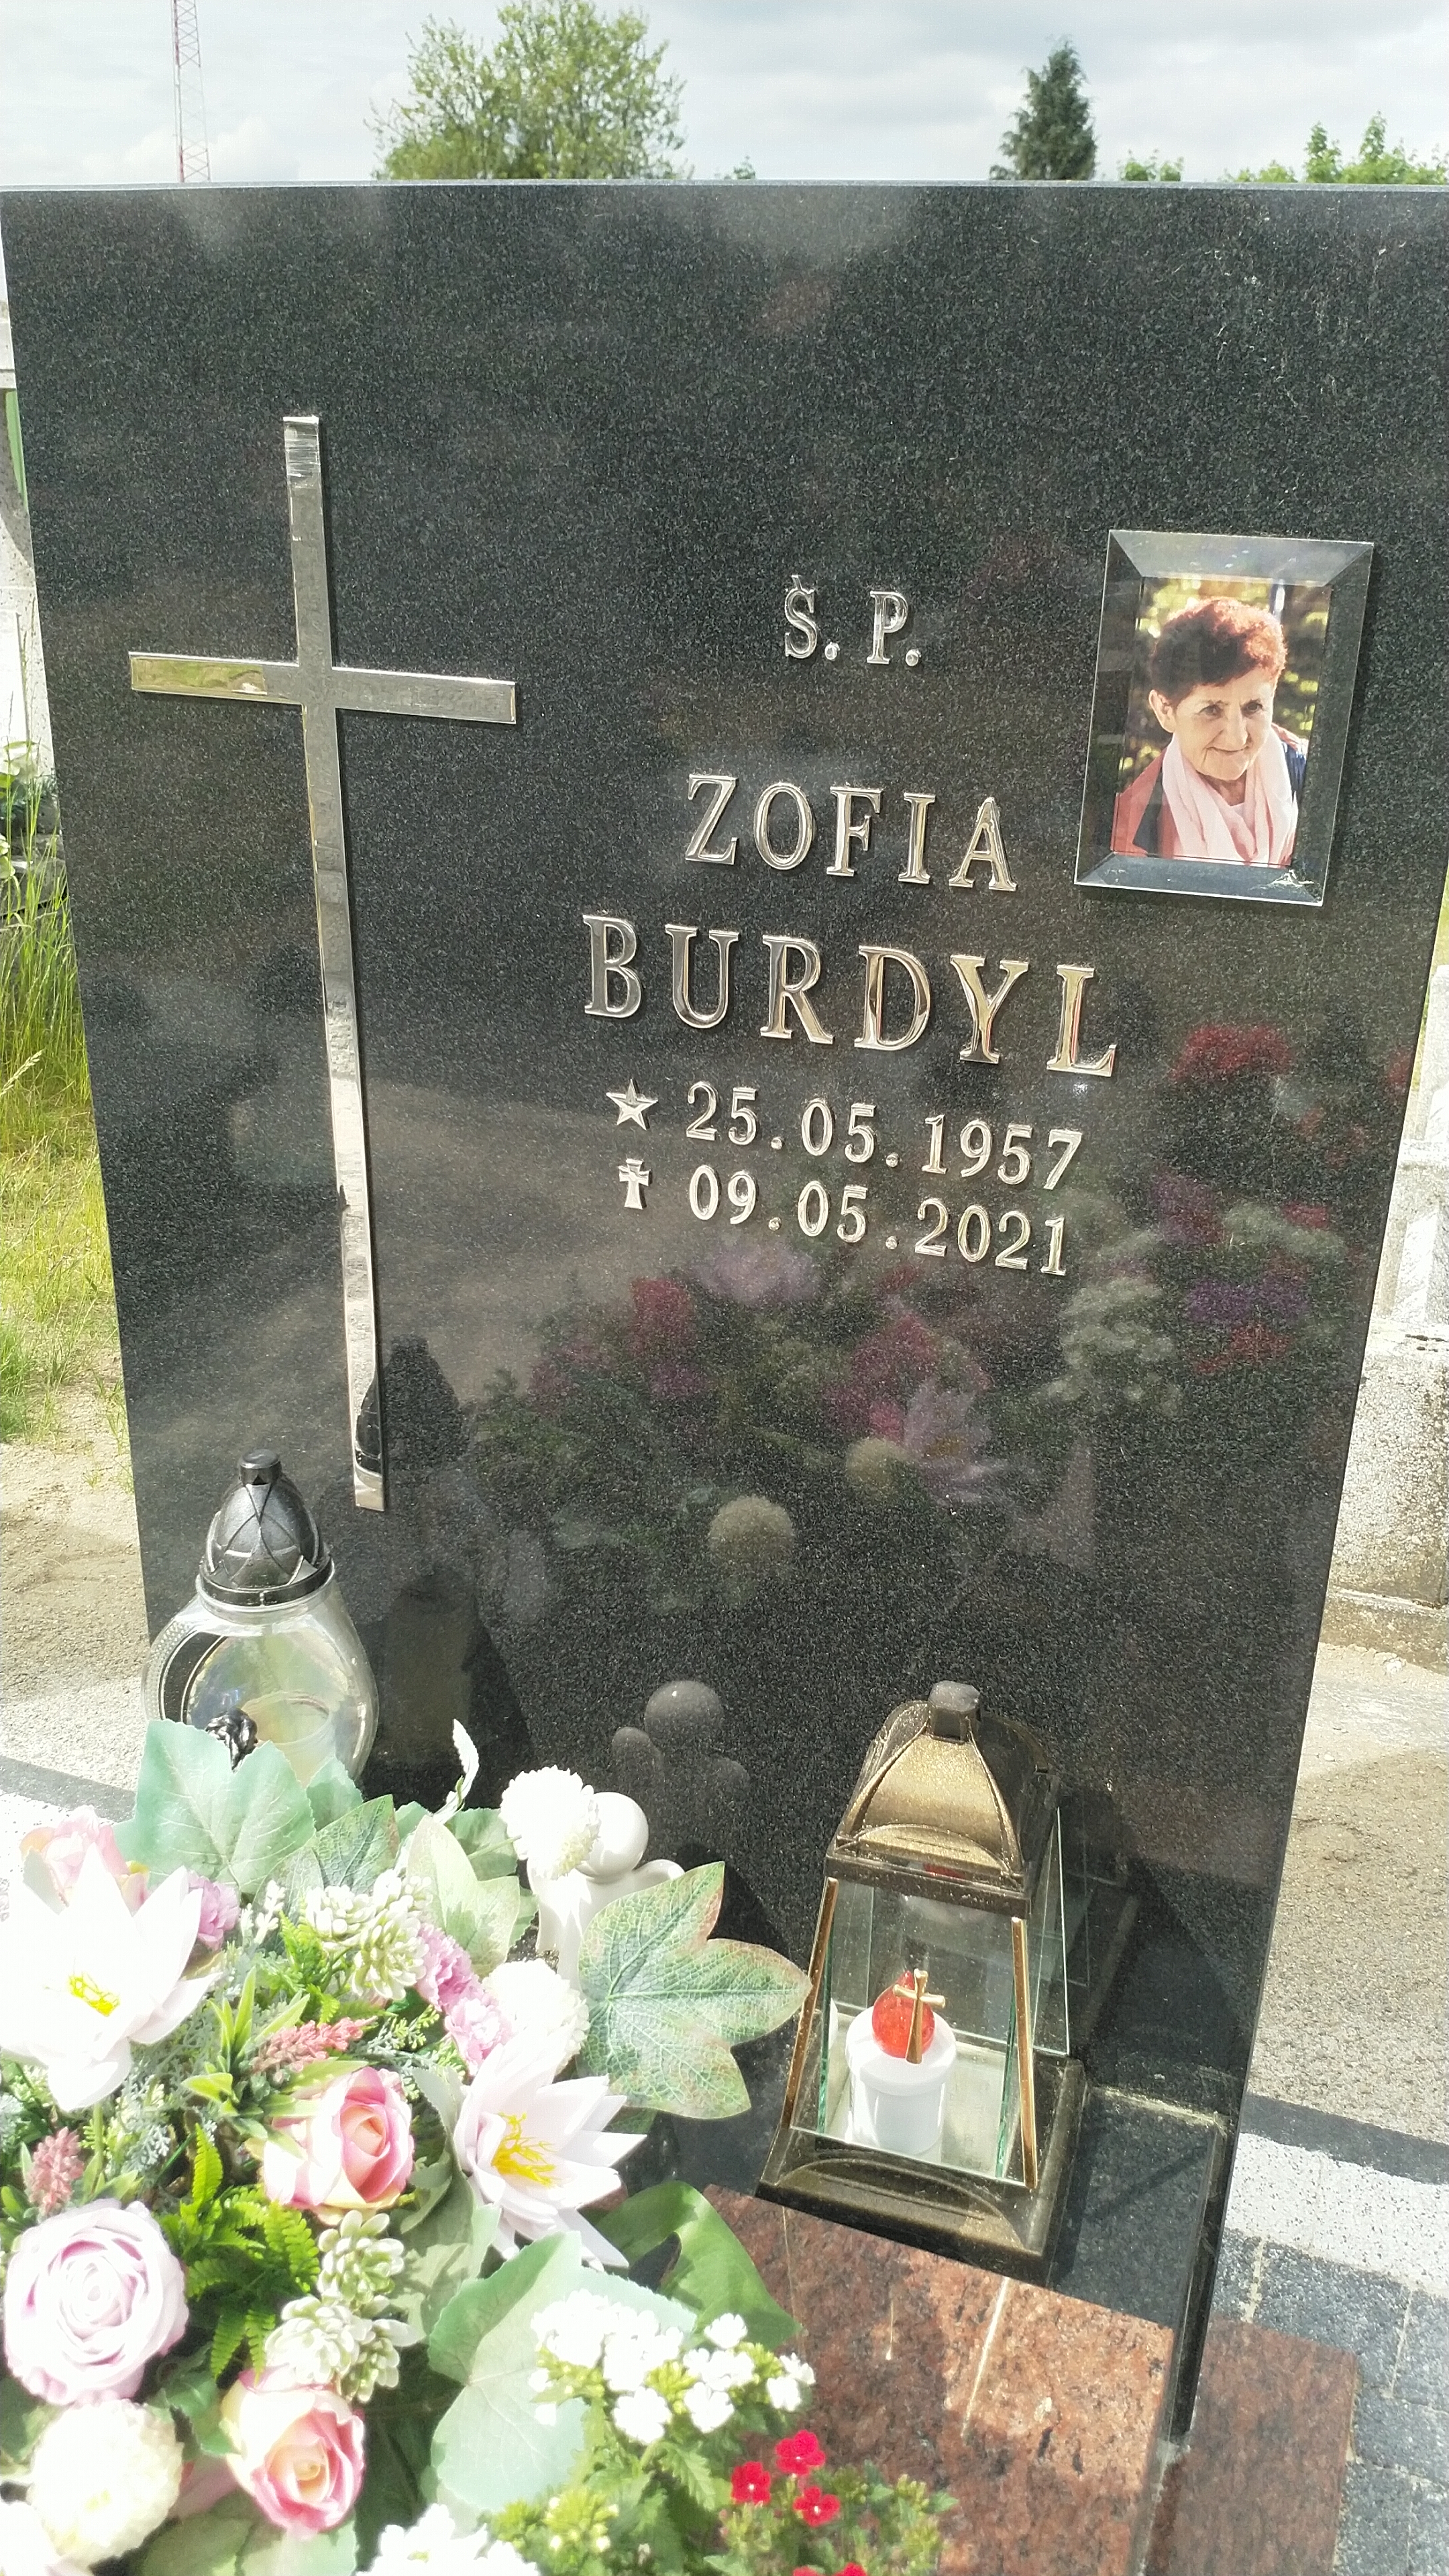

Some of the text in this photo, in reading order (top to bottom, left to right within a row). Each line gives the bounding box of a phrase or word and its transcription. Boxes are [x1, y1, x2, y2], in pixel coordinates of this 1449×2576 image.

[866, 590, 922, 666] P.
[685, 773, 1018, 892] ZOFIA
[583, 913, 1118, 1077] BURDYL
[686, 1081, 1083, 1189] 25.05.1957
[688, 1165, 1067, 1276] 09.05.2021
